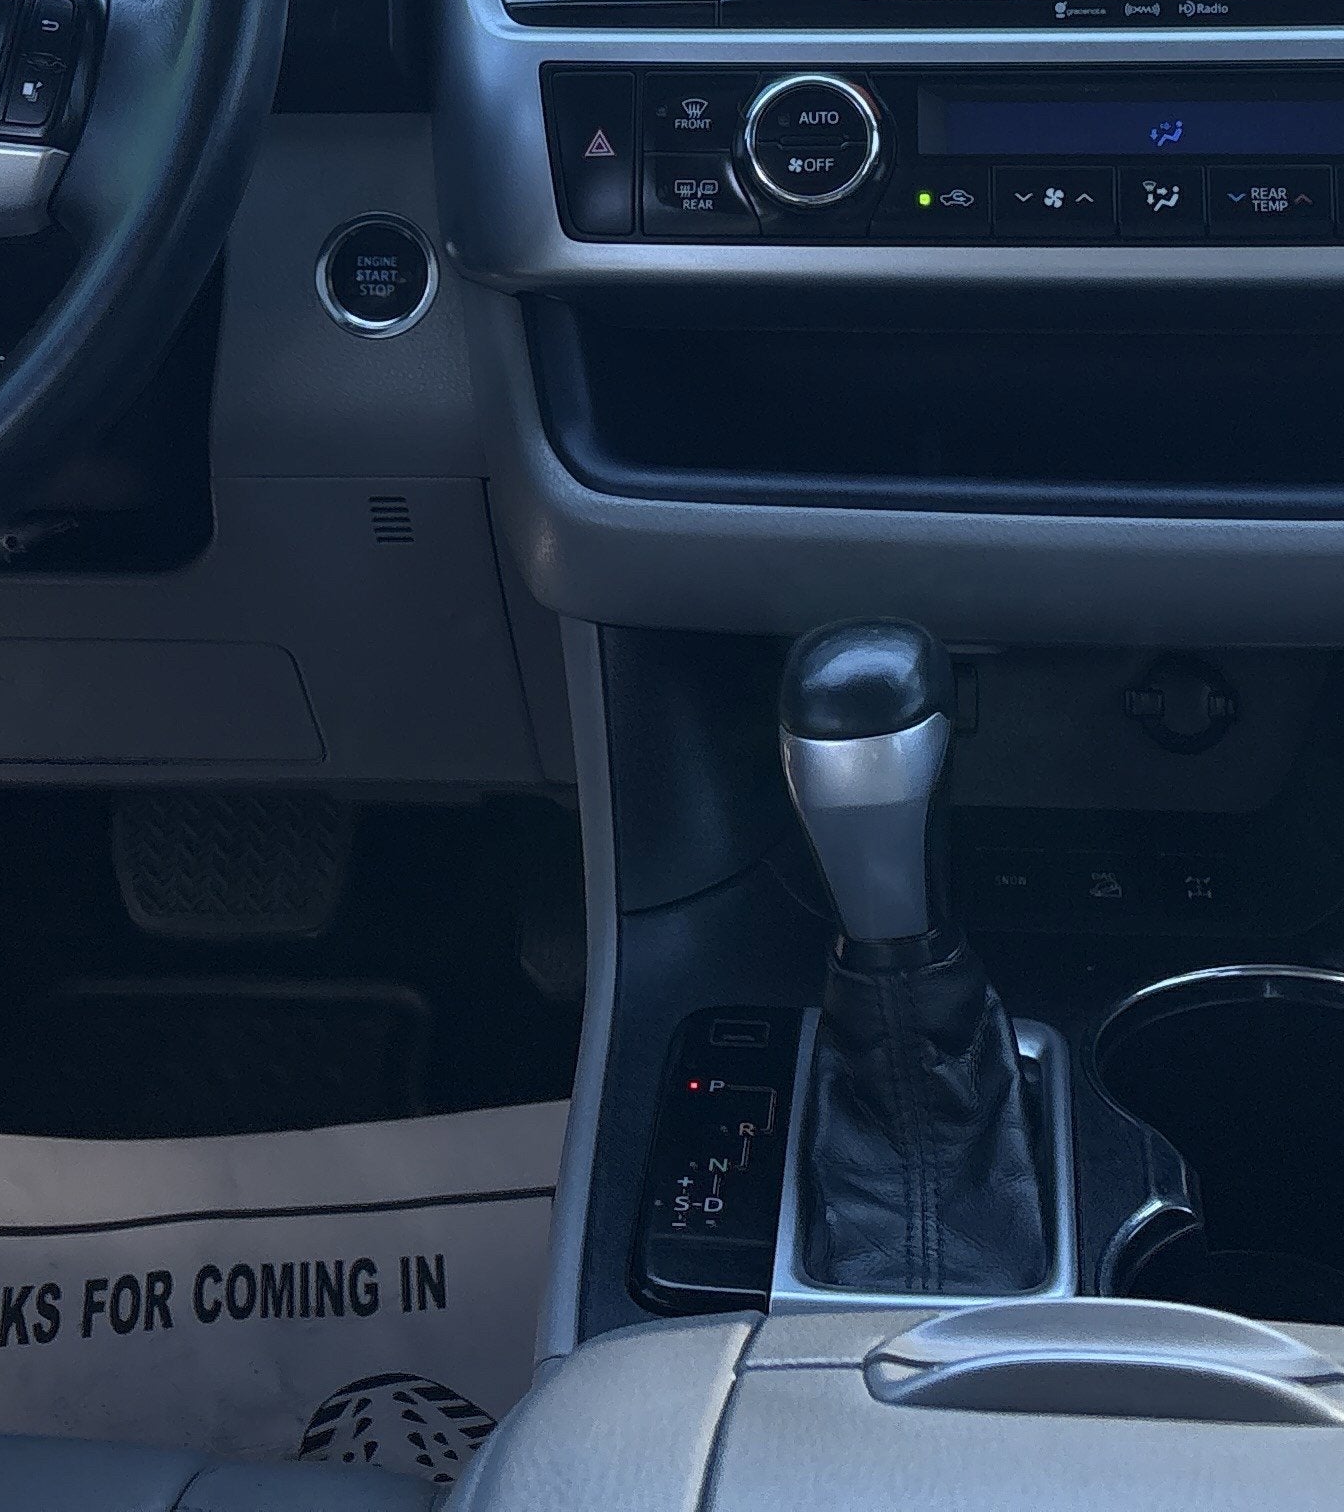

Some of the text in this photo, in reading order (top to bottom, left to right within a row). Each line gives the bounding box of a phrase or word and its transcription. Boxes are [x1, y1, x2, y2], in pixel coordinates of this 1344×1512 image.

[1197, 3, 1229, 14] Radio
[798, 111, 839, 125] AUTO
[674, 119, 712, 131] FRONT
[804, 158, 835, 173] OFF
[1250, 187, 1288, 200] REAR
[682, 199, 713, 210] REAR
[1252, 200, 1289, 213] TEMP
[357, 256, 397, 267] ENGINE
[356, 270, 398, 282] START
[359, 284, 395, 296] STOP
[709, 1080, 725, 1092] P
[739, 1122, 755, 1136] R
[708, 1158, 729, 1172] N
[673, 1196, 723, 1212] S D
[81, 1268, 175, 1339] FOR
[192, 1255, 380, 1325] COMING
[399, 1253, 449, 1314] IN
